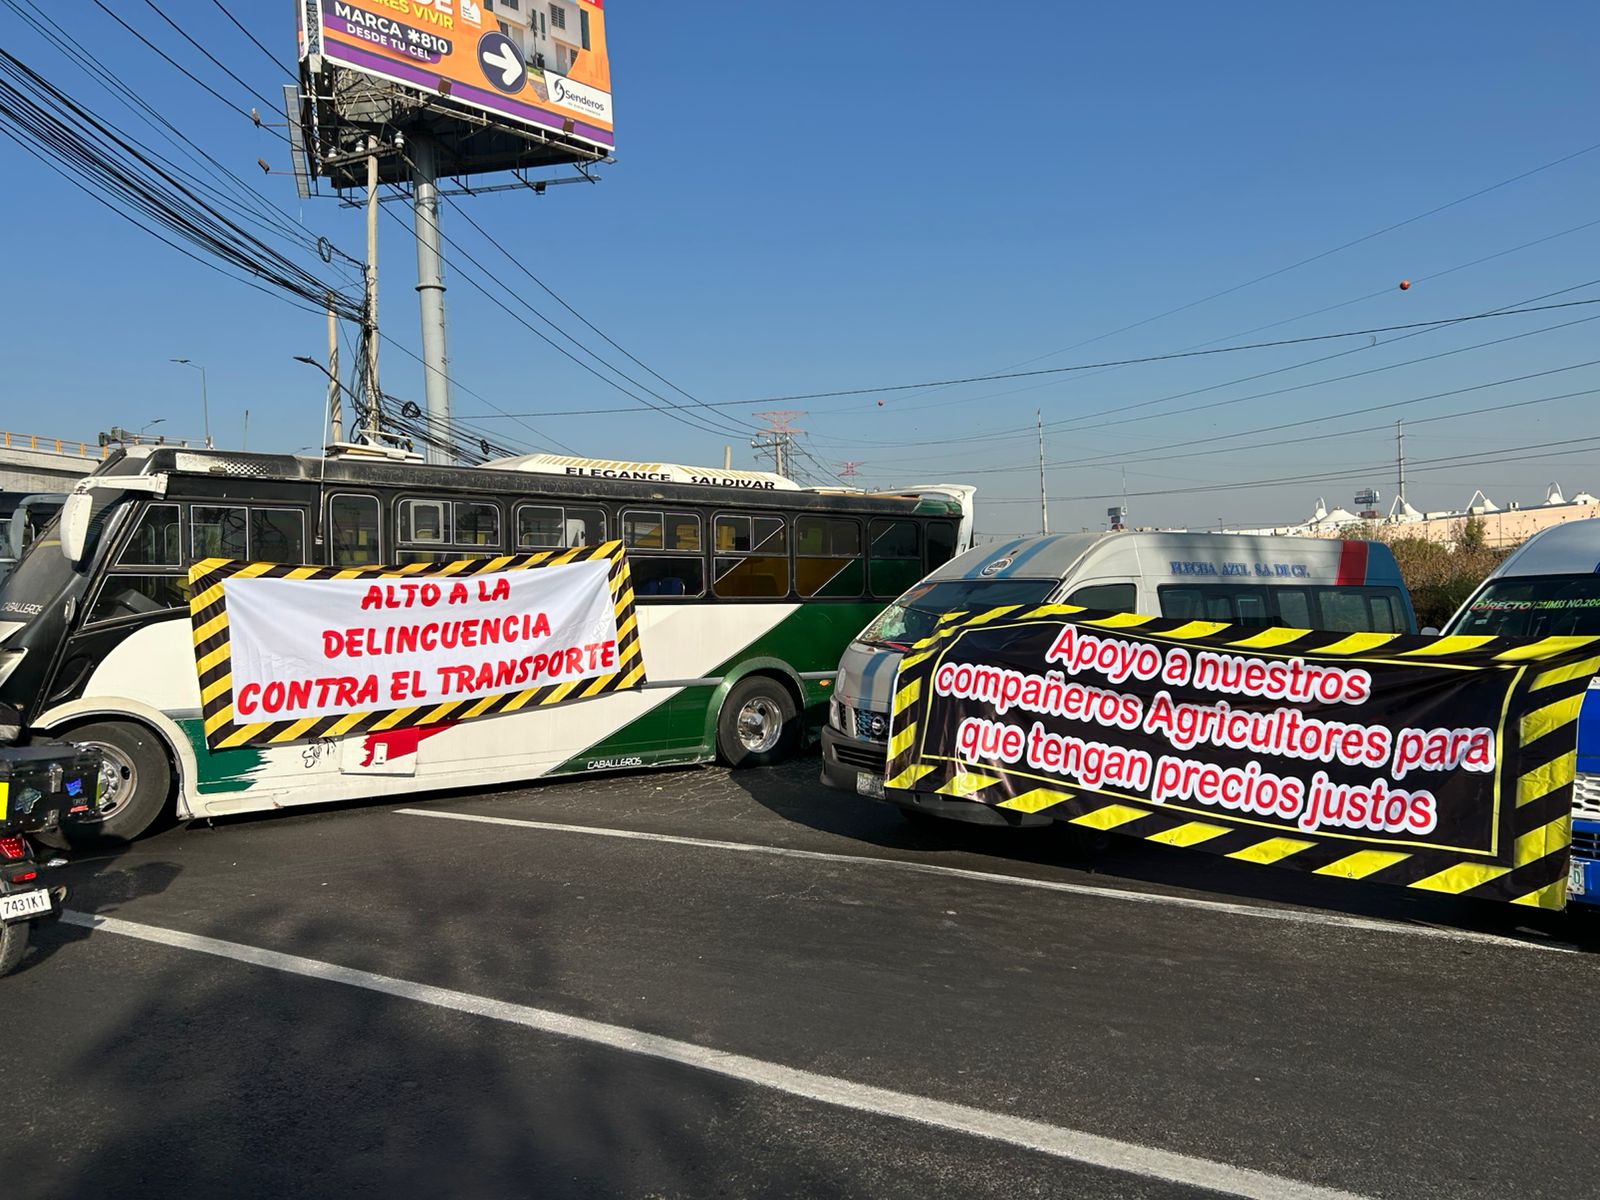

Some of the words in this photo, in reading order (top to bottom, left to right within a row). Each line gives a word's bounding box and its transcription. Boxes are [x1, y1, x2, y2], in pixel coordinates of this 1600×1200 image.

[335, 1, 403, 38] MARCA
[413, 3, 454, 30] VIVIR
[346, 23, 388, 46] DESDE
[390, 38, 406, 51] TU
[409, 45, 432, 61] CEL
[565, 90, 605, 111] Senderos
[565, 466, 671, 482] ELEGANCE
[690, 475, 776, 490] SALDIVAR
[360, 582, 442, 611] ALTO
[447, 581, 469, 606] A
[477, 577, 511, 602] LA
[1470, 599, 1532, 611] DIRECTO
[321, 612, 551, 660] DELINCUENCIA
[236, 673, 379, 717] CONTRA
[389, 670, 428, 702] EL
[436, 640, 617, 696] TRANSPORTE
[1047, 625, 1161, 681] Apoyo
[1163, 649, 1191, 685] a
[1194, 656, 1370, 704] nuestros
[936, 664, 1142, 729] compañeros
[1145, 693, 1391, 766] Agricultores
[1394, 729, 1494, 778] para
[587, 757, 643, 770] CABALLEROS
[959, 719, 1024, 762] que
[1028, 723, 1151, 788] tengan
[1153, 757, 1303, 818] precios
[1300, 773, 1436, 832] justos
[4, 895, 46, 915] 7431K1
